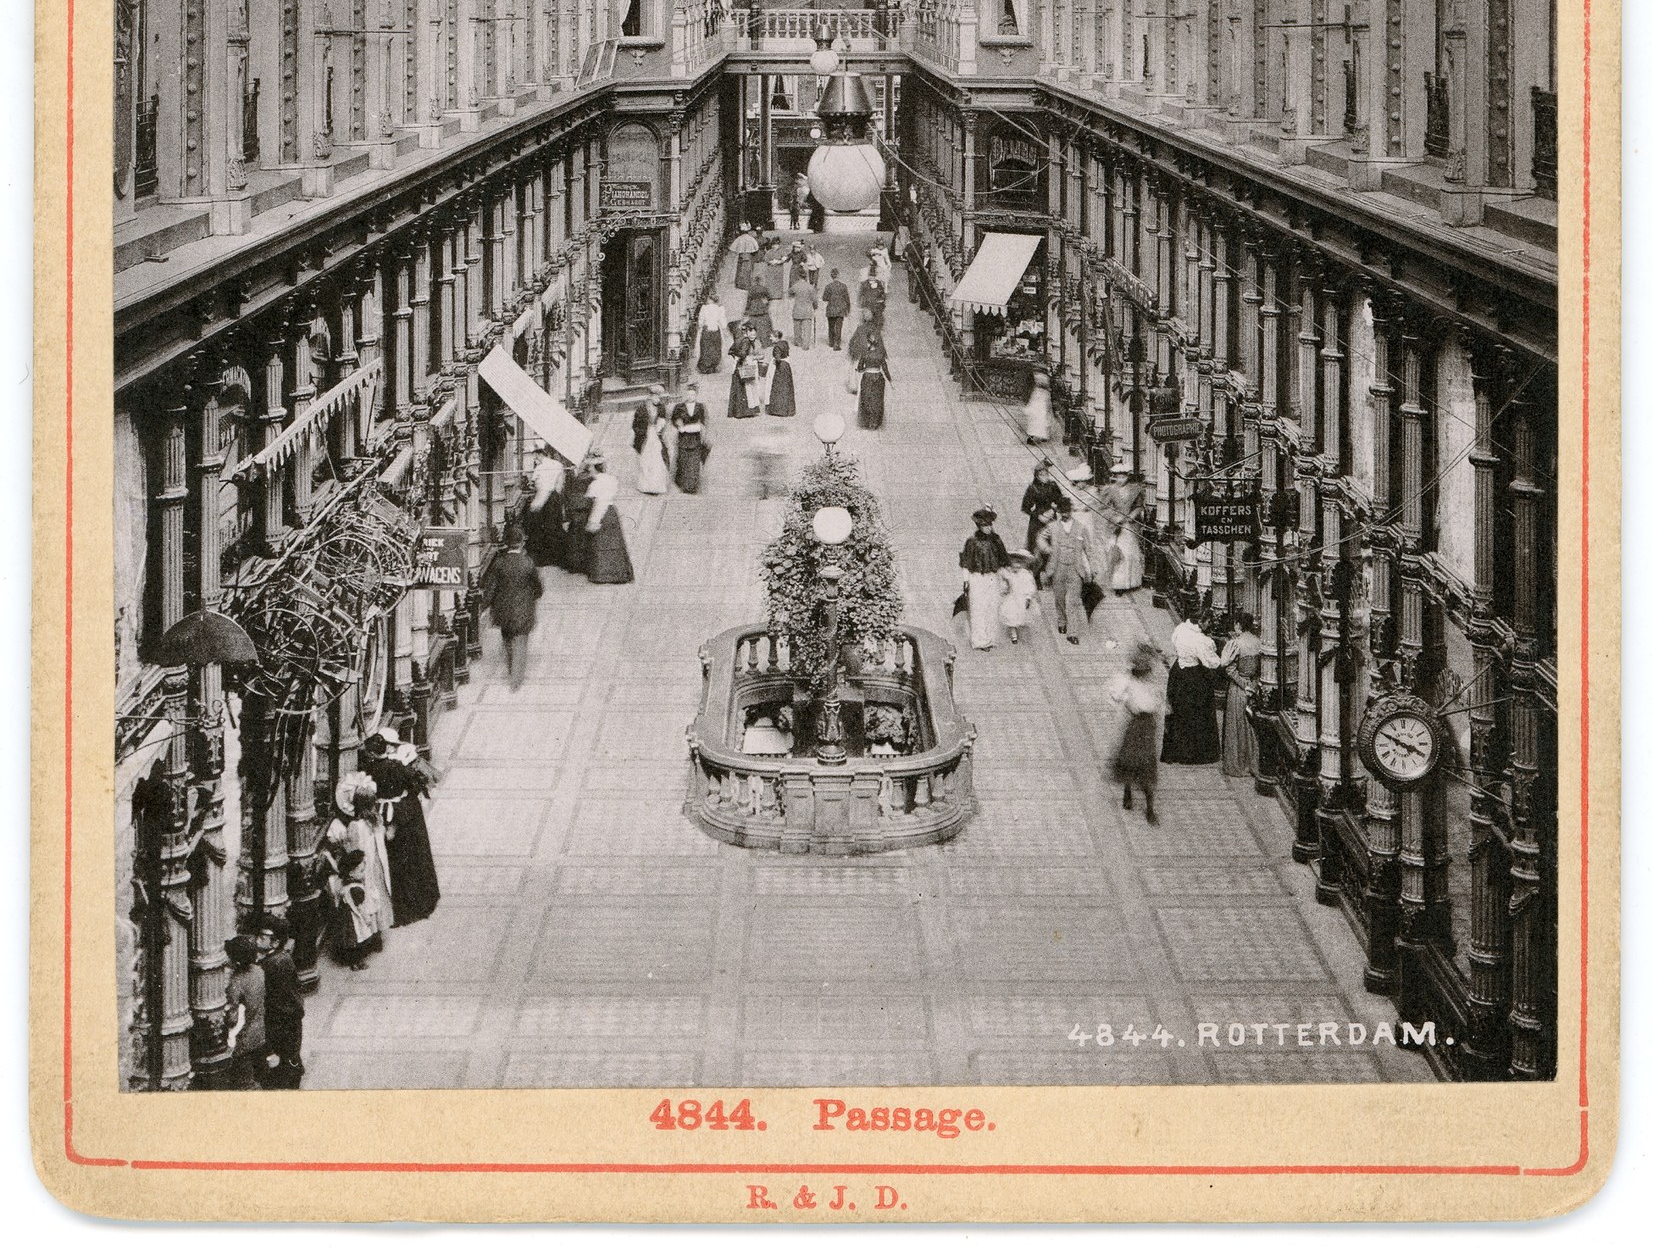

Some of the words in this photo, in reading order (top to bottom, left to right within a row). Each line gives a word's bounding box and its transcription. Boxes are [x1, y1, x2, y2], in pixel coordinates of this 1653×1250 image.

[1200, 505, 1252, 516] KOFFERS
[1201, 525, 1252, 535] TASSCHEN
[650, 1098, 768, 1130] 4844.
[812, 1099, 997, 1139] Passage.
[746, 1185, 778, 1210] R.
[793, 1184, 817, 1209] &
[829, 1185, 856, 1210] J.
[874, 1185, 908, 1211] D.
